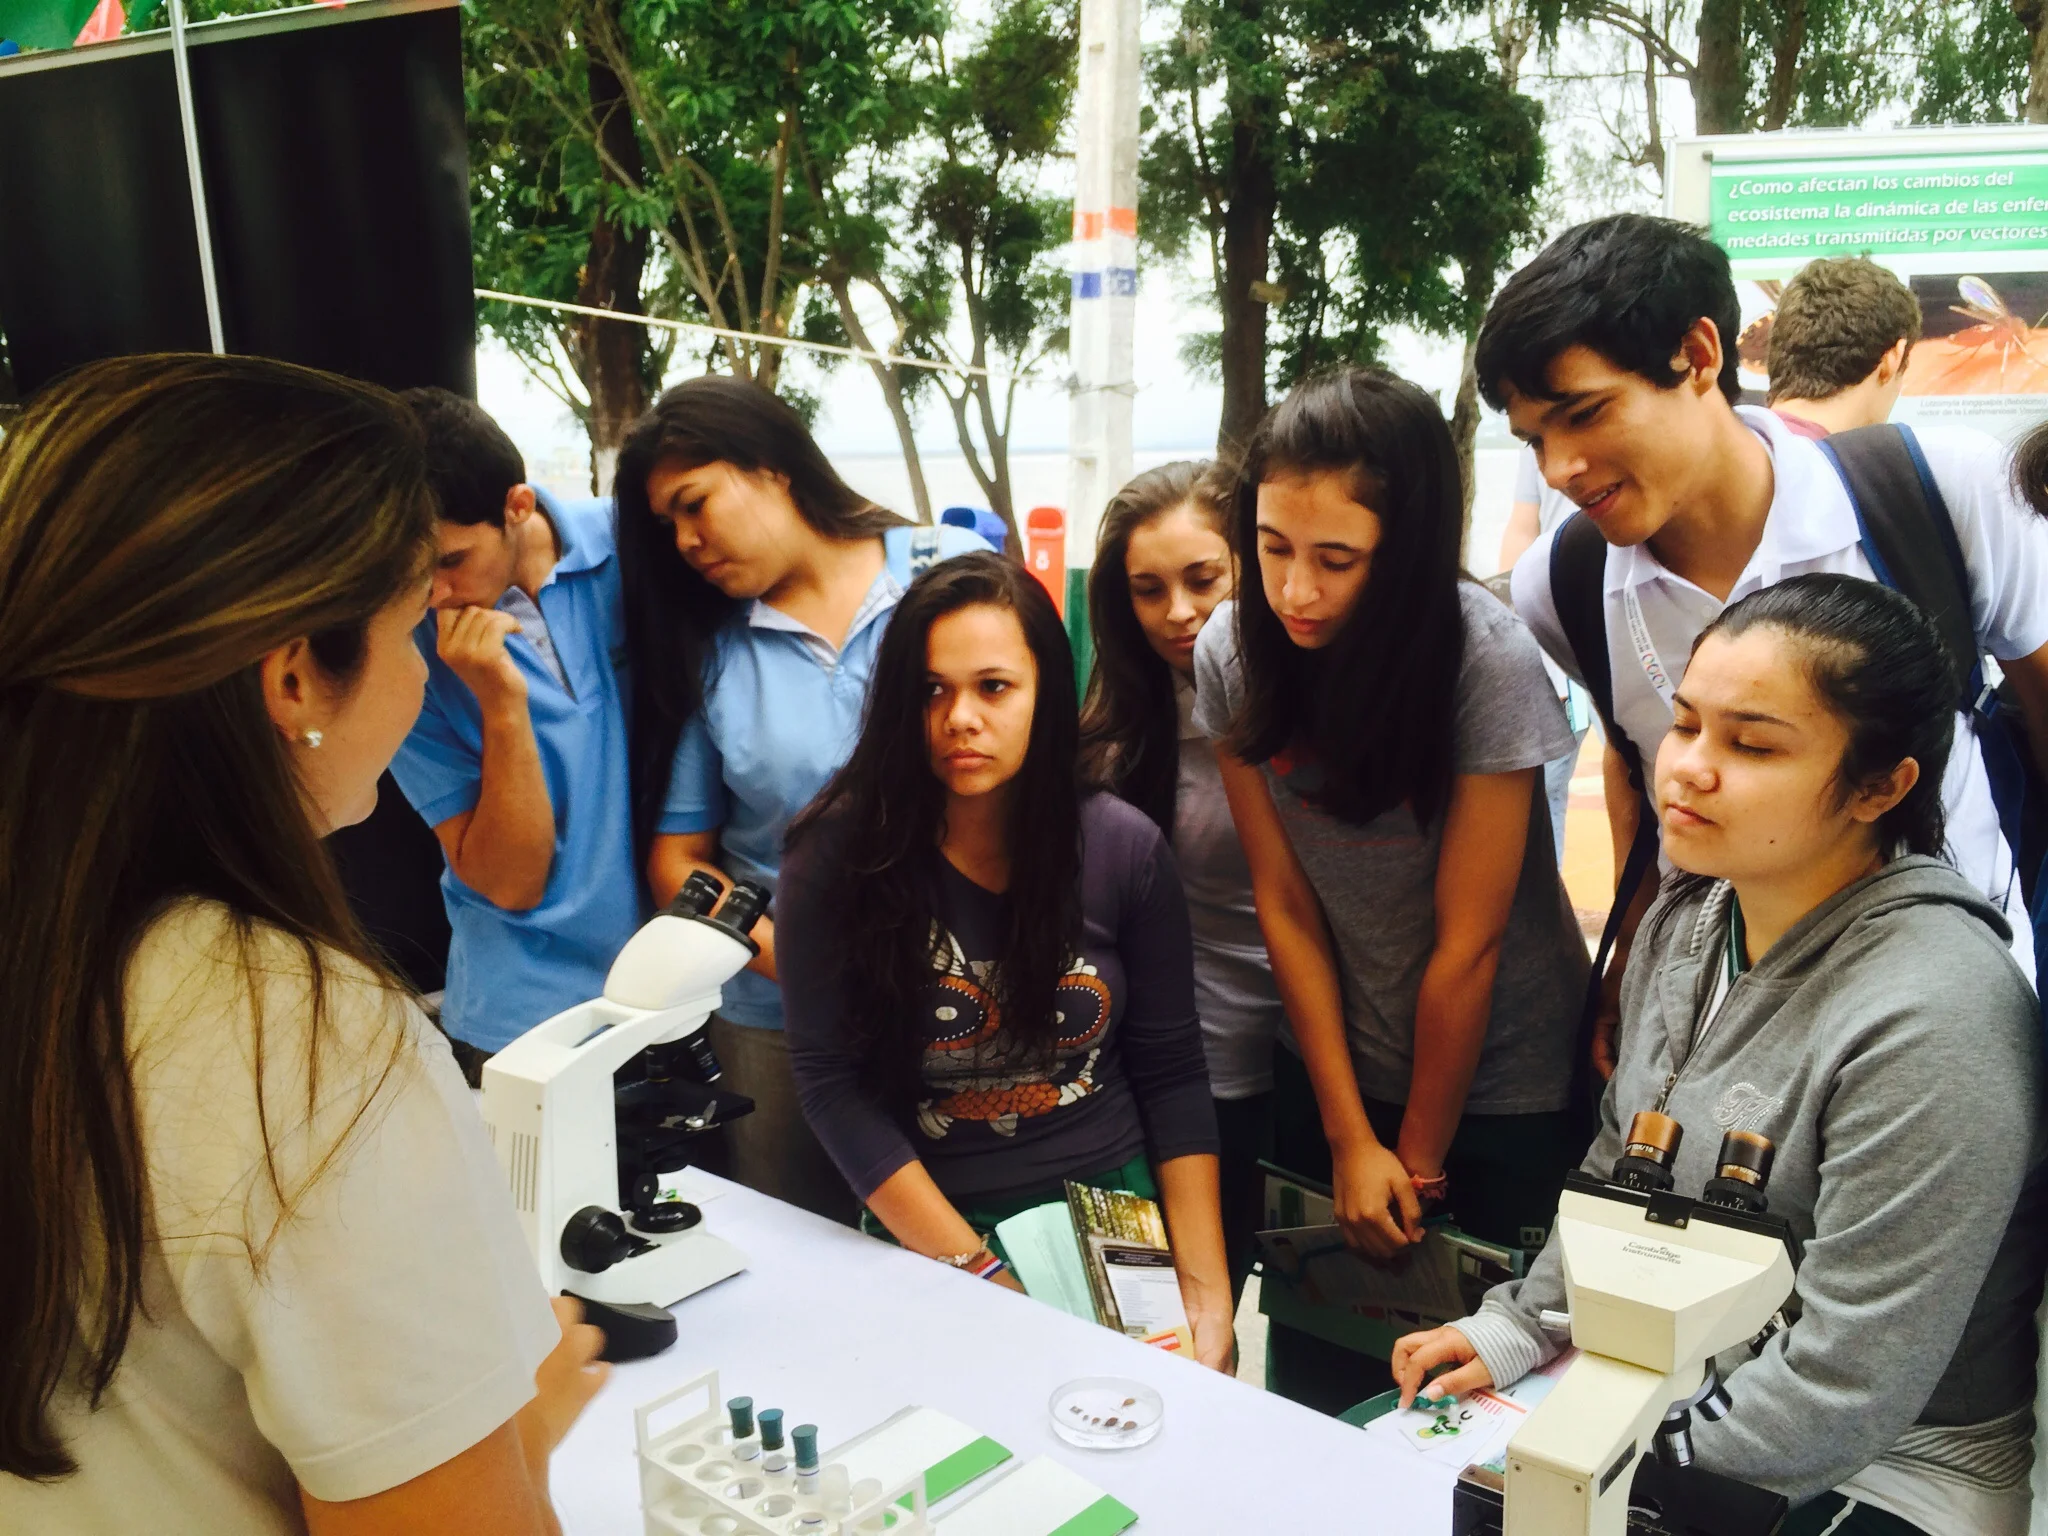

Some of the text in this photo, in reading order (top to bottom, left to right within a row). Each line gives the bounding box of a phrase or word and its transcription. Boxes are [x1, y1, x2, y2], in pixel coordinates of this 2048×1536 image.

[1728, 171, 2014, 199] ¿Como afectan los cambios del
[1727, 205, 1830, 222] ecosistema
[1834, 203, 1850, 218] la
[1855, 201, 1940, 218] dinámica
[1944, 199, 1968, 215] de
[1973, 198, 1998, 214] las
[1726, 225, 2048, 249] medades transmitidas por vectores
[1622, 1246, 1681, 1265] Instruments
[1628, 1241, 1681, 1259] Cambridge
